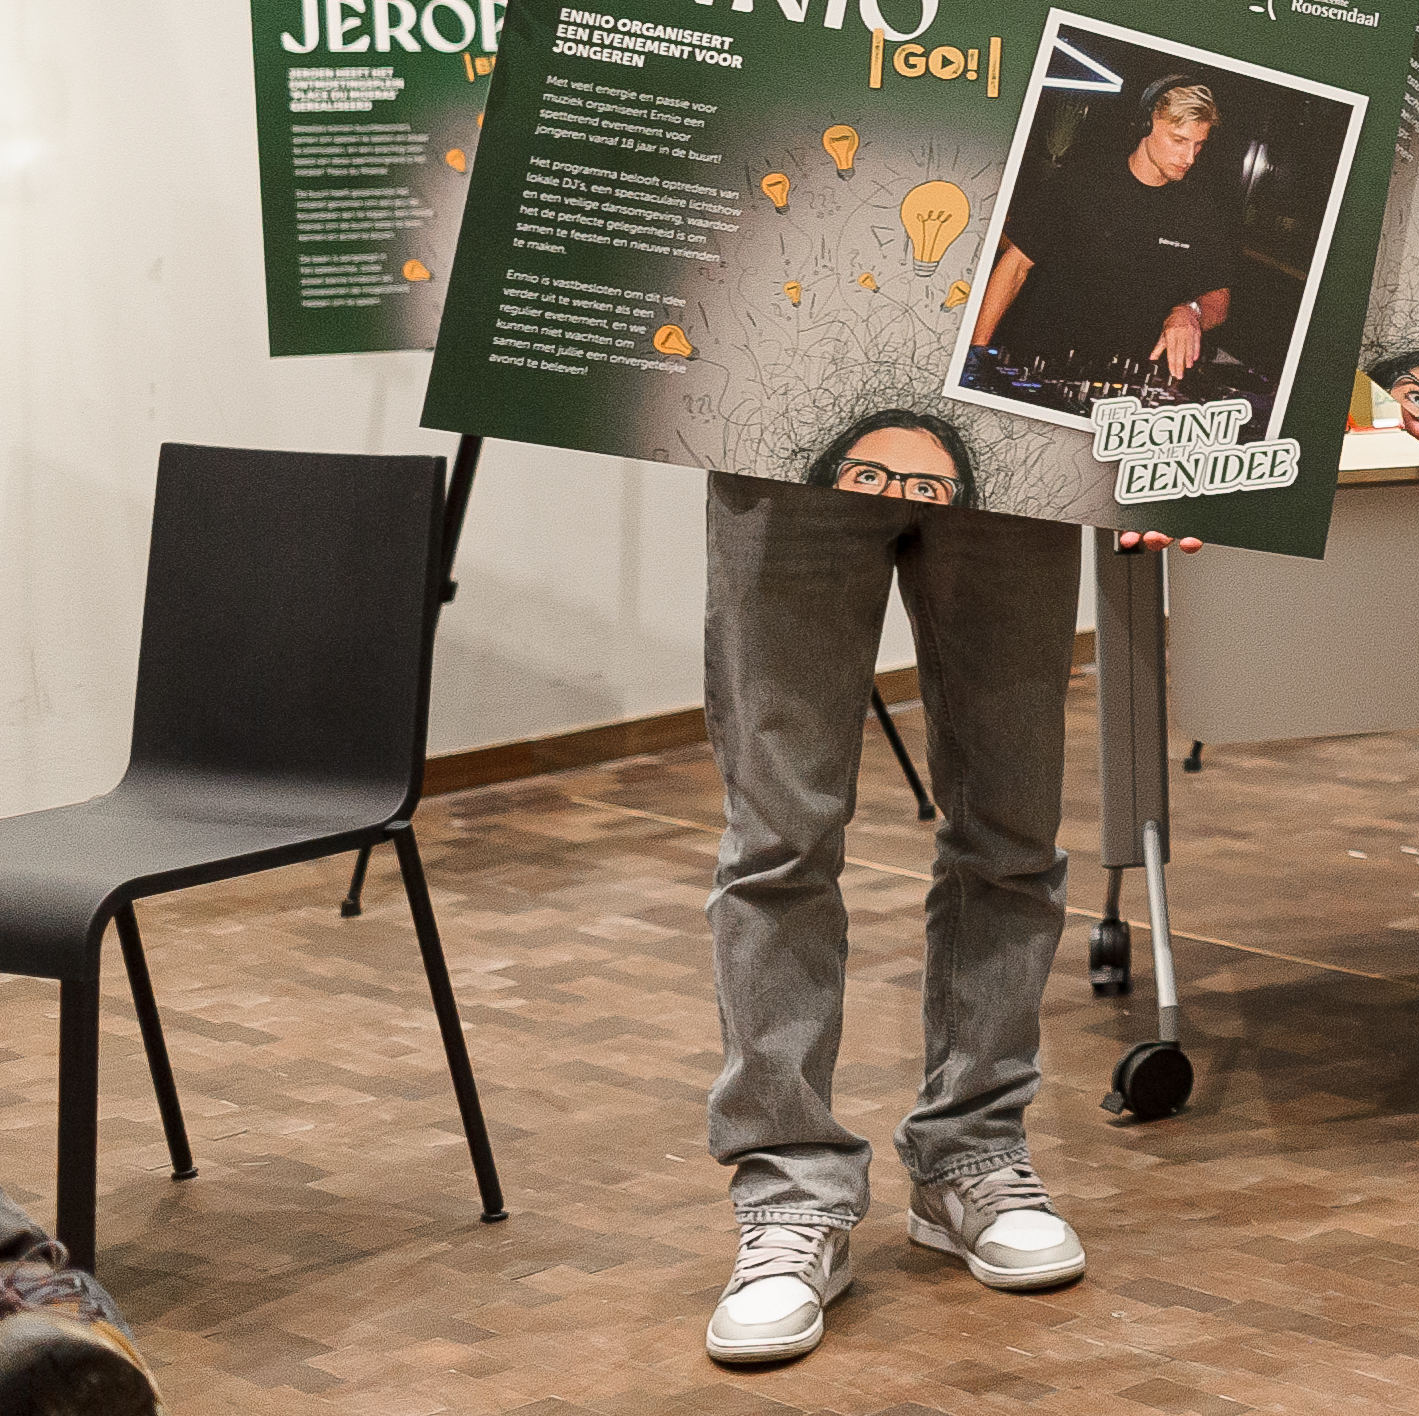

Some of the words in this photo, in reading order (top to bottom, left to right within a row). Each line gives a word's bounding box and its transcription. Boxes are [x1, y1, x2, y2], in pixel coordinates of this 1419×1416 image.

[555, 23, 590, 42] EEN
[591, 29, 694, 60] EVENEMENT
[694, 47, 743, 69] VOOR
[559, 7, 615, 29] ENNIO
[616, 18, 734, 51] ORGANISEERT
[552, 39, 646, 68] JONGEREN
[542, 93, 585, 107] muziek
[585, 100, 648, 119] organiseert
[649, 109, 682, 124] Ennio
[683, 117, 705, 128] een
[545, 74, 569, 88] Met
[570, 81, 594, 92] veel
[594, 85, 638, 101] energie
[638, 93, 654, 102] en
[655, 96, 691, 110] passie
[691, 102, 719, 114] voor
[534, 125, 587, 141] jongeren
[587, 134, 620, 146] vanaf
[620, 137, 635, 149] 18
[634, 142, 658, 153] jaar
[658, 146, 670, 155] in
[671, 147, 687, 158] de
[687, 149, 723, 165] buurt!
[539, 108, 600, 127] spetterend
[600, 119, 664, 138] evenement
[665, 131, 692, 142] voor
[1103, 409, 1242, 452] BEGINT
[1125, 457, 1201, 494] EEN
[1208, 448, 1291, 485] IDEE
